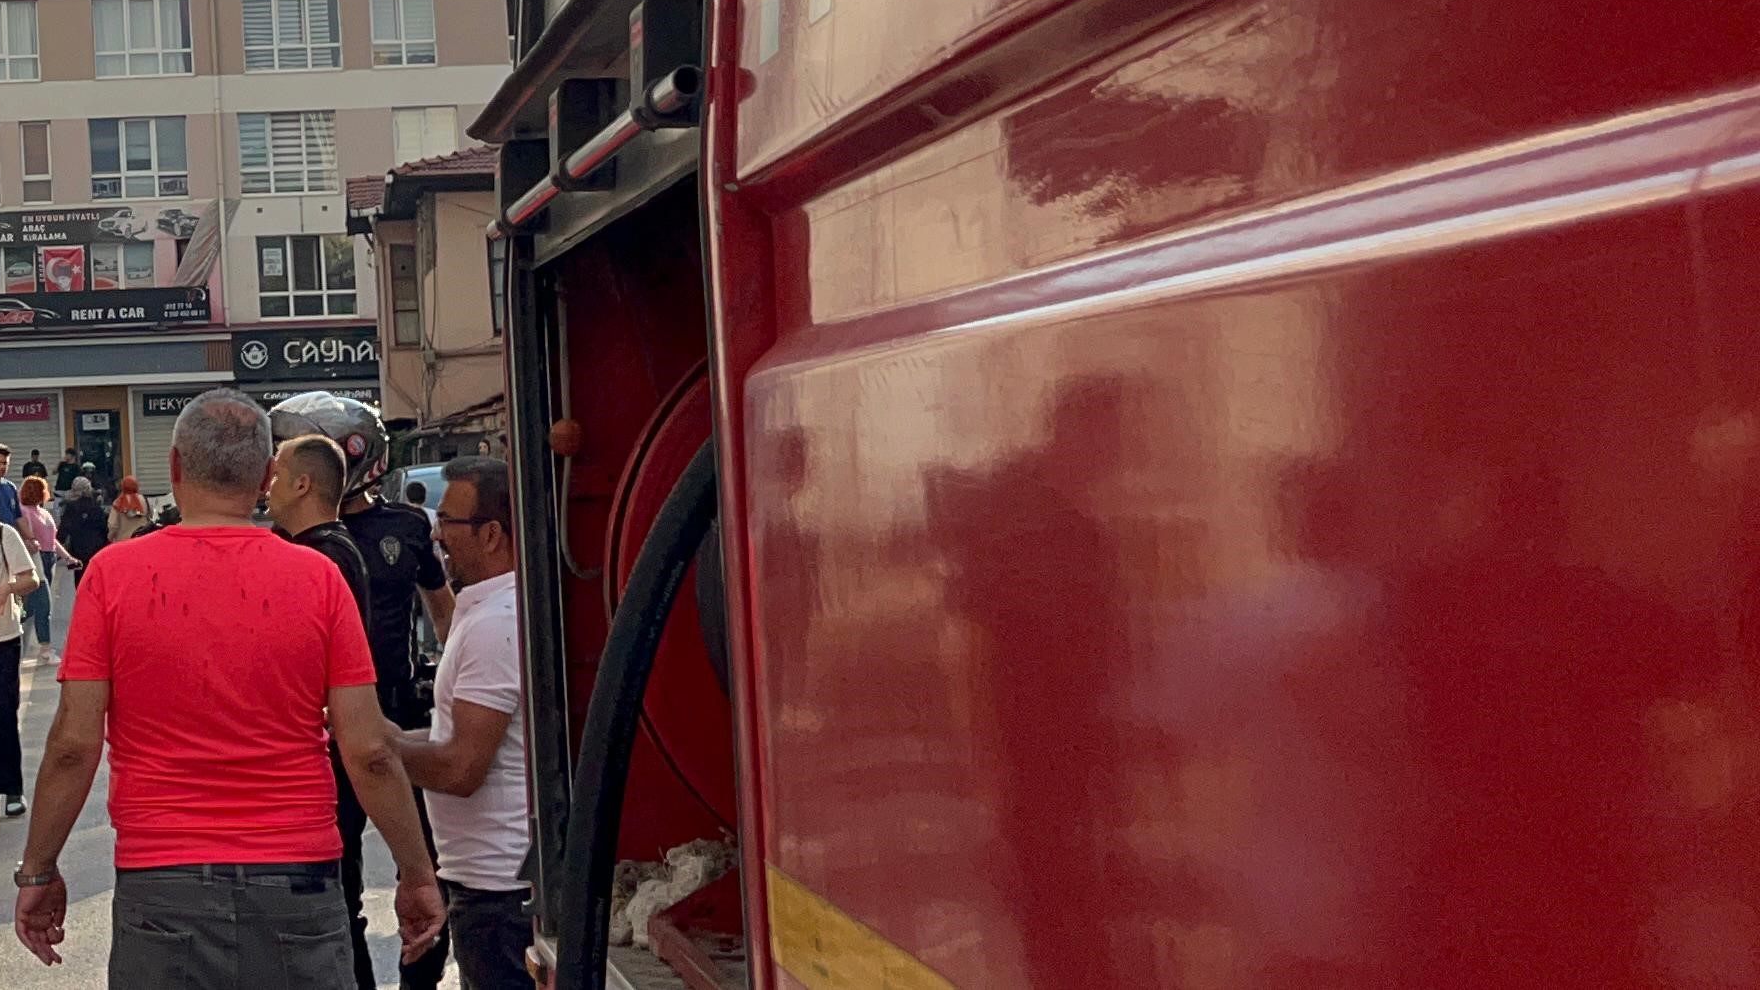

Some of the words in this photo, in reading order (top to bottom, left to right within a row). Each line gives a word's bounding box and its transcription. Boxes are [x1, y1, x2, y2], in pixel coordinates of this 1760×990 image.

[71, 309, 103, 321] RENT
[107, 309, 115, 319] A
[119, 307, 145, 319] CAR
[7, 404, 43, 415] TWIST
